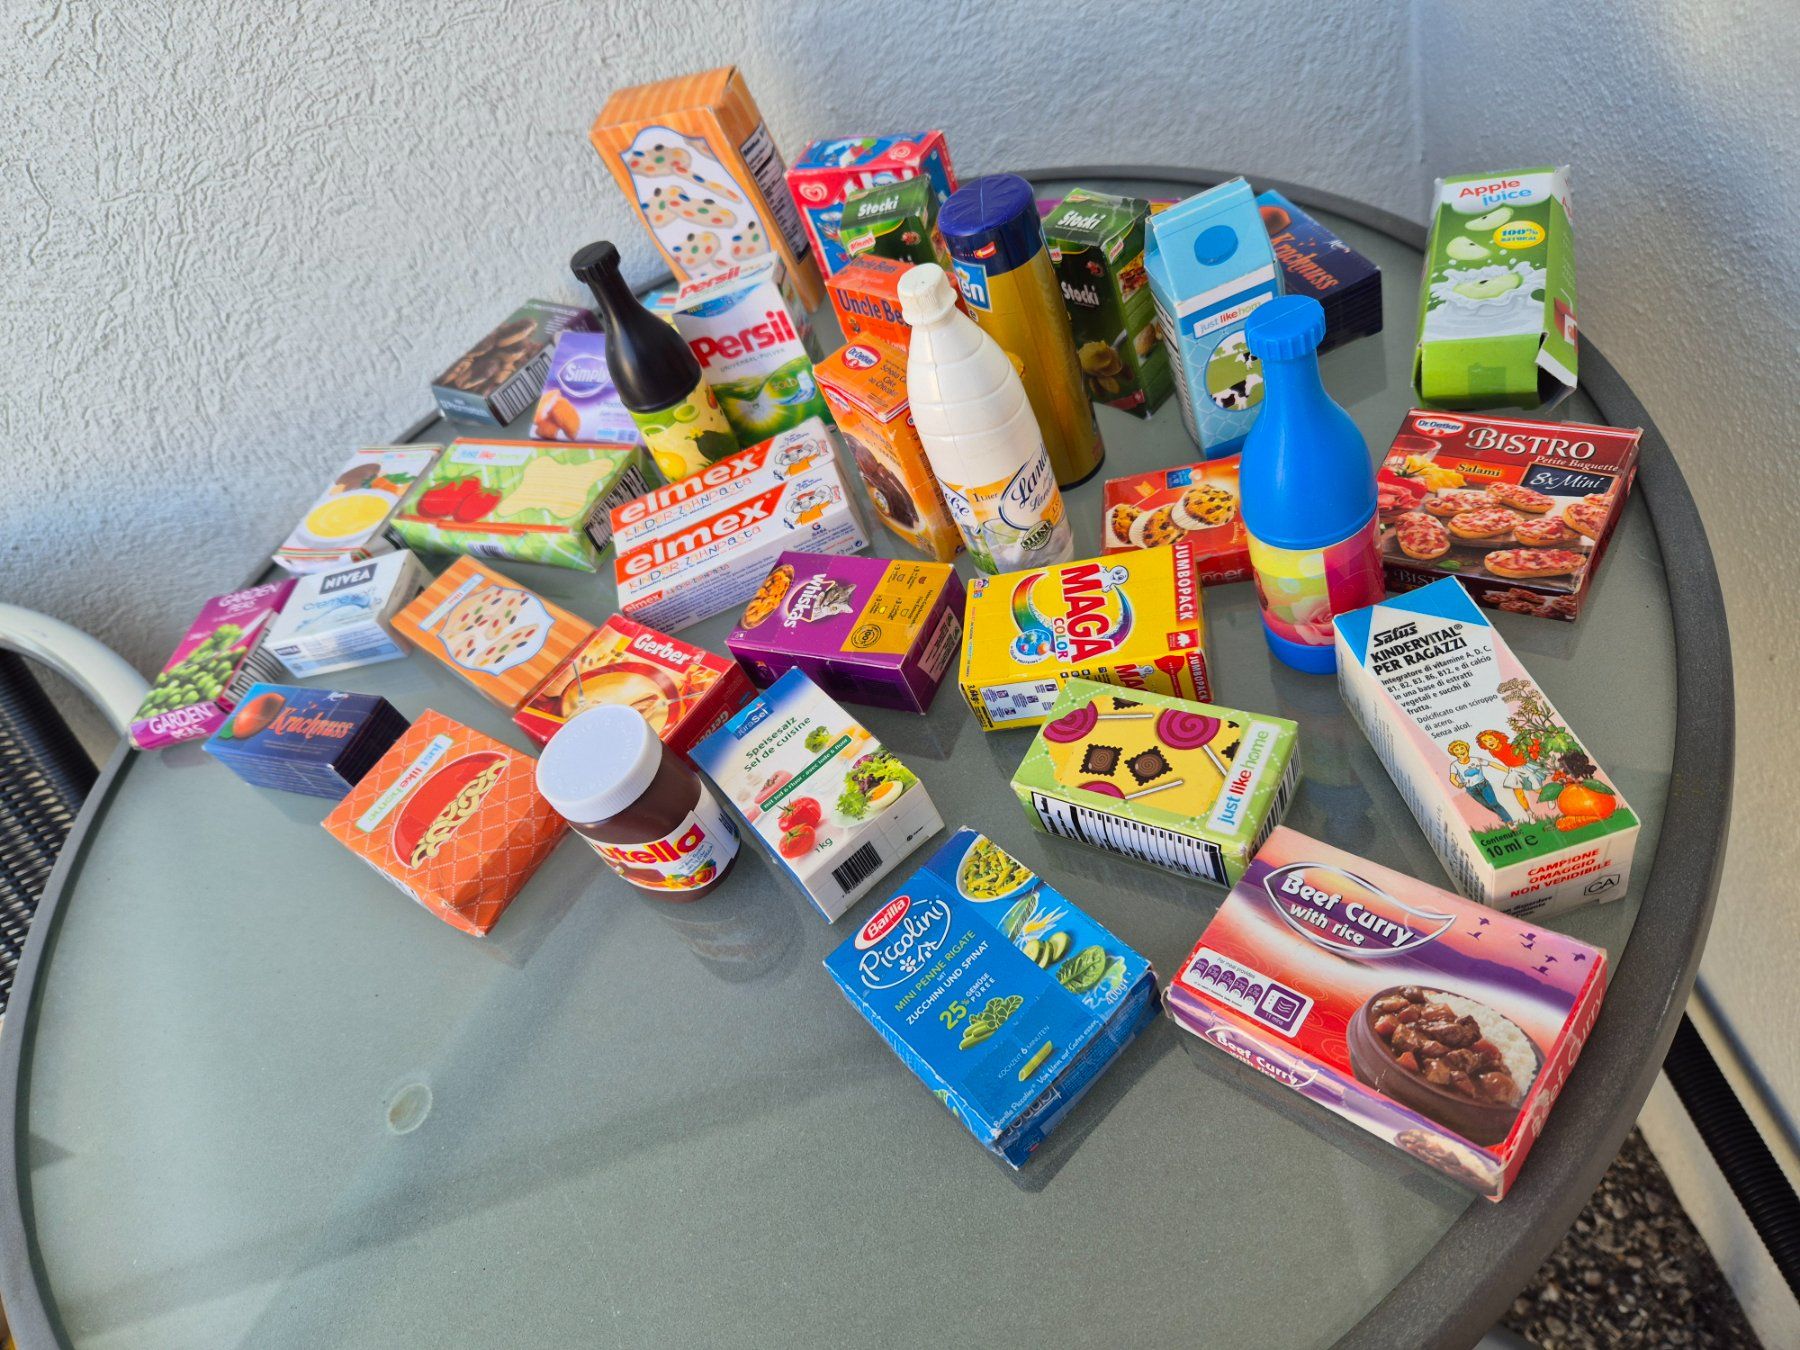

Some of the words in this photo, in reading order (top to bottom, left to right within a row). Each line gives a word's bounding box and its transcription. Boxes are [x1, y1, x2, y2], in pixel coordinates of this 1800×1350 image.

[1459, 180, 1520, 198] Apple
[1483, 188, 1532, 206] juice
[858, 196, 899, 217] Stocki
[1057, 210, 1106, 230] Stocki
[680, 266, 740, 298] Persil
[1061, 282, 1100, 306] Stocki
[836, 287, 882, 319] Uncle
[880, 299, 912, 328] Be
[1220, 310, 1238, 323] like
[1239, 301, 1261, 314] hom
[688, 310, 796, 369] Persil
[1417, 419, 1462, 432] Dr.Oetker
[1465, 427, 1596, 460] BISTRO
[1457, 462, 1502, 478] Salami
[1535, 455, 1566, 467] Petite
[1570, 459, 1620, 474] Baguette
[620, 452, 759, 524] elmex
[1557, 474, 1602, 491] Mini
[624, 500, 770, 575] elmex
[325, 568, 371, 589] NIVEA
[1174, 544, 1194, 620] JUMBOPACK
[1393, 569, 1438, 585] BIST
[218, 583, 277, 608] GARDEN
[625, 592, 663, 613] elmex
[1060, 563, 1115, 664] MAGA
[633, 633, 691, 665] Gerber
[1053, 617, 1069, 660] COLOR
[1373, 622, 1418, 648] Salus
[1372, 659, 1404, 676] PER
[1405, 637, 1468, 667] RAGAZZI
[1381, 668, 1423, 686] Integratore
[1424, 664, 1432, 673] di
[1433, 655, 1465, 671] vitamine
[1466, 651, 1475, 660] A,
[1461, 661, 1469, 670] di
[1470, 655, 1492, 668] calcio
[1189, 656, 1208, 701] JUMBOPACK
[1394, 693, 1402, 701] in
[1403, 689, 1418, 698] una
[1419, 683, 1436, 695] base
[1437, 679, 1445, 688] di
[1446, 671, 1474, 685] estratti
[1401, 693, 1431, 708] vegetali
[1438, 684, 1463, 697] succhi
[1464, 681, 1471, 689] di
[1416, 707, 1454, 725] Dolcificato
[1455, 703, 1468, 712] con
[1468, 693, 1498, 710] sciroppo
[150, 703, 214, 734] GARDEN
[1406, 704, 1433, 716] frutta.
[171, 724, 206, 739] PEAS
[762, 747, 775, 759] de
[776, 717, 811, 747] cuisine
[1424, 723, 1433, 732] di
[1433, 718, 1455, 730] acero.
[1430, 728, 1453, 739] Senza
[1454, 722, 1473, 734] alcol.
[1246, 729, 1269, 770] home
[399, 767, 422, 788] like
[1229, 769, 1251, 795] like
[1219, 796, 1241, 825] just
[595, 823, 706, 863] utella
[819, 837, 833, 850] kg
[1486, 844, 1504, 859] 10
[1506, 840, 1522, 853] ml
[1527, 848, 1600, 877] CAMPIONE
[1529, 859, 1596, 884] OMAGGIO
[1510, 883, 1540, 898] NON
[1543, 859, 1612, 887] VENDIBILE
[867, 899, 907, 939] Barilla
[1281, 873, 1342, 911] Beef
[1345, 902, 1416, 947] Curry
[1290, 903, 1329, 929] with
[1332, 922, 1365, 946] rice
[859, 900, 944, 981] Piccolini
[895, 989, 917, 1012] MINI
[915, 960, 947, 991] PENNE
[944, 930, 976, 962] RIGATE
[906, 986, 945, 1026] ZUCCHINI
[943, 968, 963, 988] UND
[962, 940, 989, 970] SPINAT
[1021, 1047, 1028, 1055] 6
[1068, 1033, 1085, 1051] Gutes
[1216, 1031, 1251, 1058] Beef
[1256, 1056, 1298, 1086] Curry
